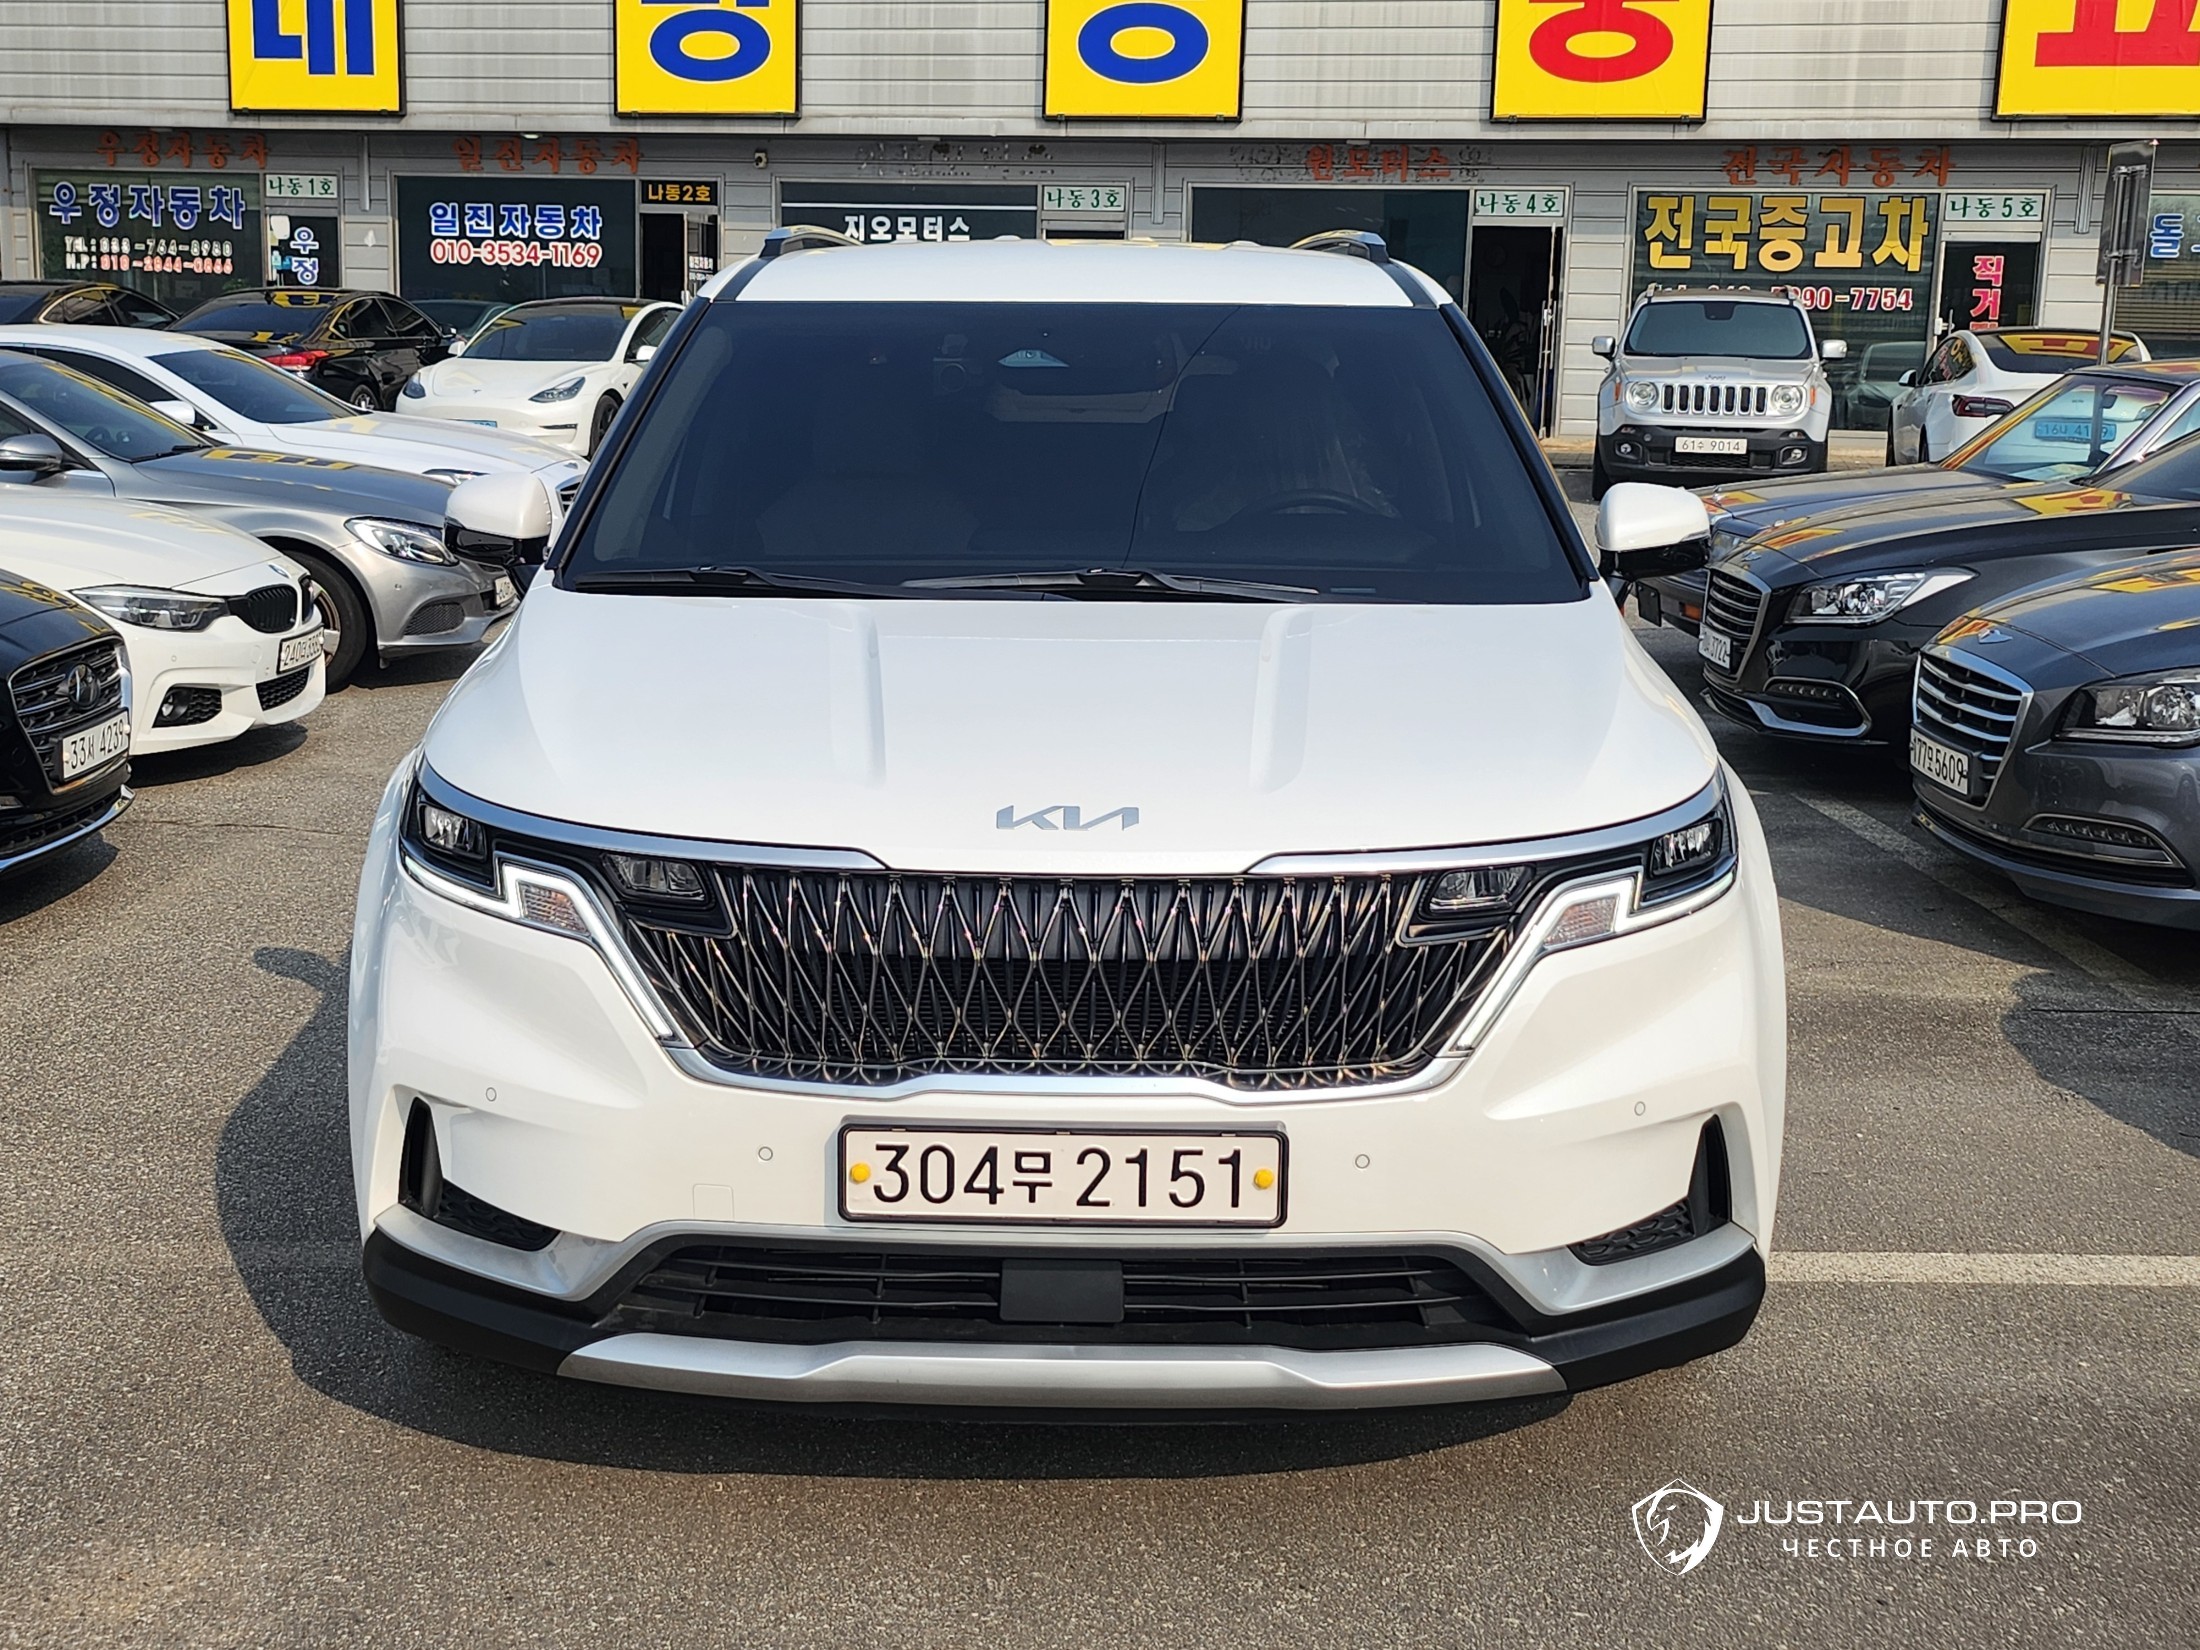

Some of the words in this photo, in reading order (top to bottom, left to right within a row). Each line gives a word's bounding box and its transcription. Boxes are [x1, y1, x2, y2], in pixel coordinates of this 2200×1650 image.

[49, 181, 246, 230] 우정자동차
[429, 202, 602, 239] 일진자동차
[844, 215, 971, 242] 지오모터스
[1644, 195, 1930, 272] 전국중고차
[290, 227, 319, 285] 우정
[430, 239, 602, 267] 010-3534-1169
[1969, 255, 2004, 330] 직거
[100, 719, 123, 756] 4239
[1935, 747, 1964, 787] 5609
[873, 1144, 1053, 1205] 304무
[1076, 1147, 1240, 1208] 2151
